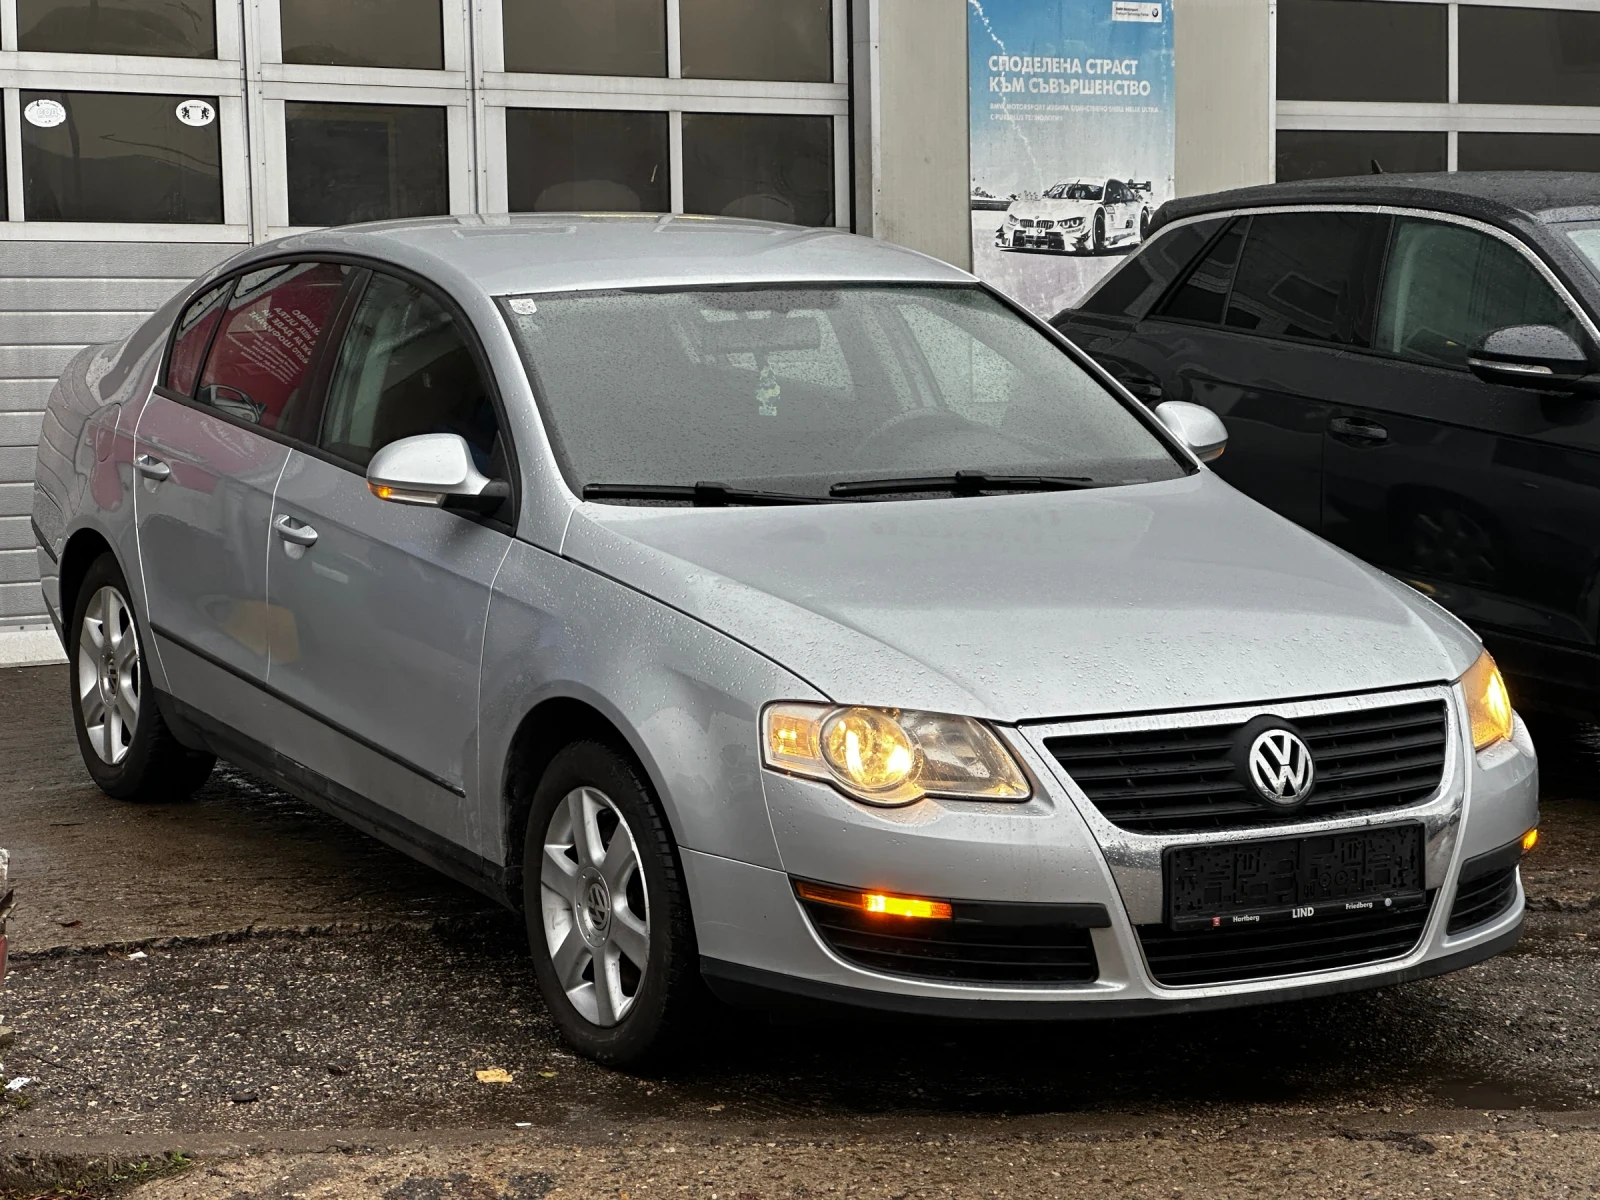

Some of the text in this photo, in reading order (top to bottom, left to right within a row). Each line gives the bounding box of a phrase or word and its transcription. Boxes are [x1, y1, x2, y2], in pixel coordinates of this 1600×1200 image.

[988, 55, 1139, 75] СПОДЕЛЕНА СТРАСТ
[989, 76, 1151, 96] КЪМ СЪВЪРШЕНСТВО
[1006, 103, 1046, 111] MOTORSPORT
[1249, 729, 1314, 805] VW
[1232, 901, 1373, 923] Hartberg LIND Friedberg
